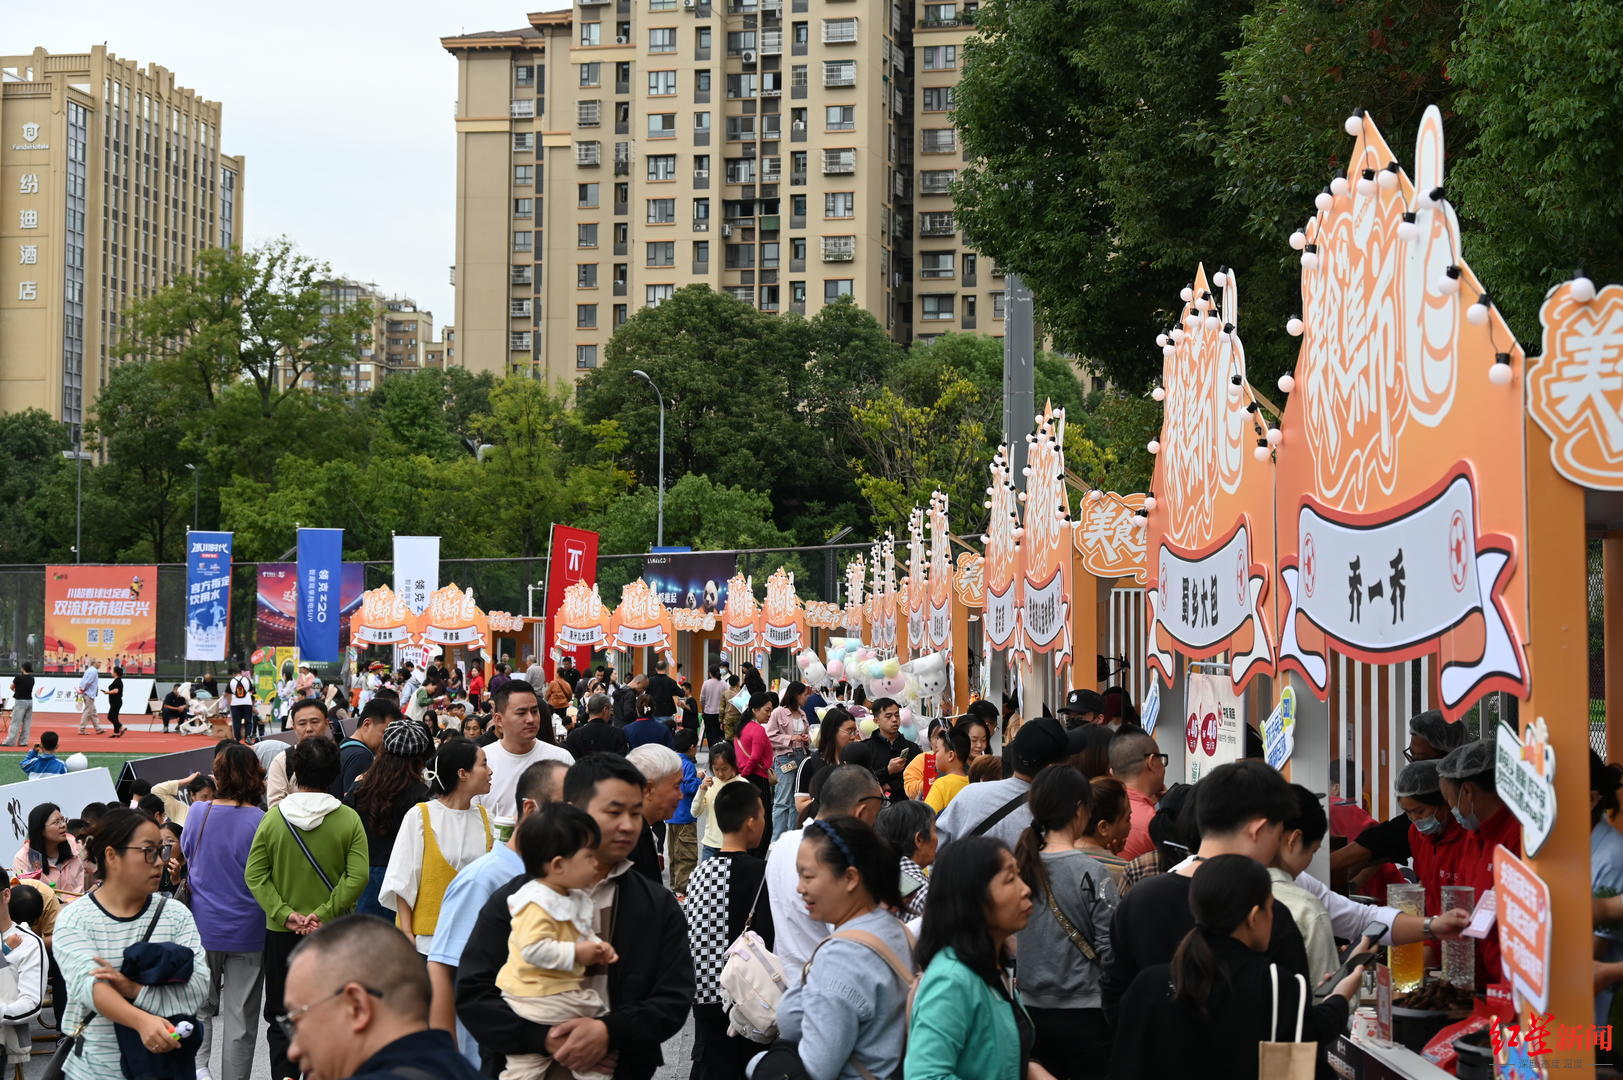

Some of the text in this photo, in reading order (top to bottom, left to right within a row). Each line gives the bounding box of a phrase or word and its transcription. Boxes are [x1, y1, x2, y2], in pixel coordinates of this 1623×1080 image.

[191, 542, 229, 553] 冰川时代
[191, 576, 230, 594] 官方指定
[415, 579, 425, 603] 领克
[1347, 548, 1407, 625] 乔一乔
[190, 588, 220, 606] 饮用水
[317, 569, 329, 623] 领克 Z20
[53, 600, 150, 617] 双流好市超尽兴
